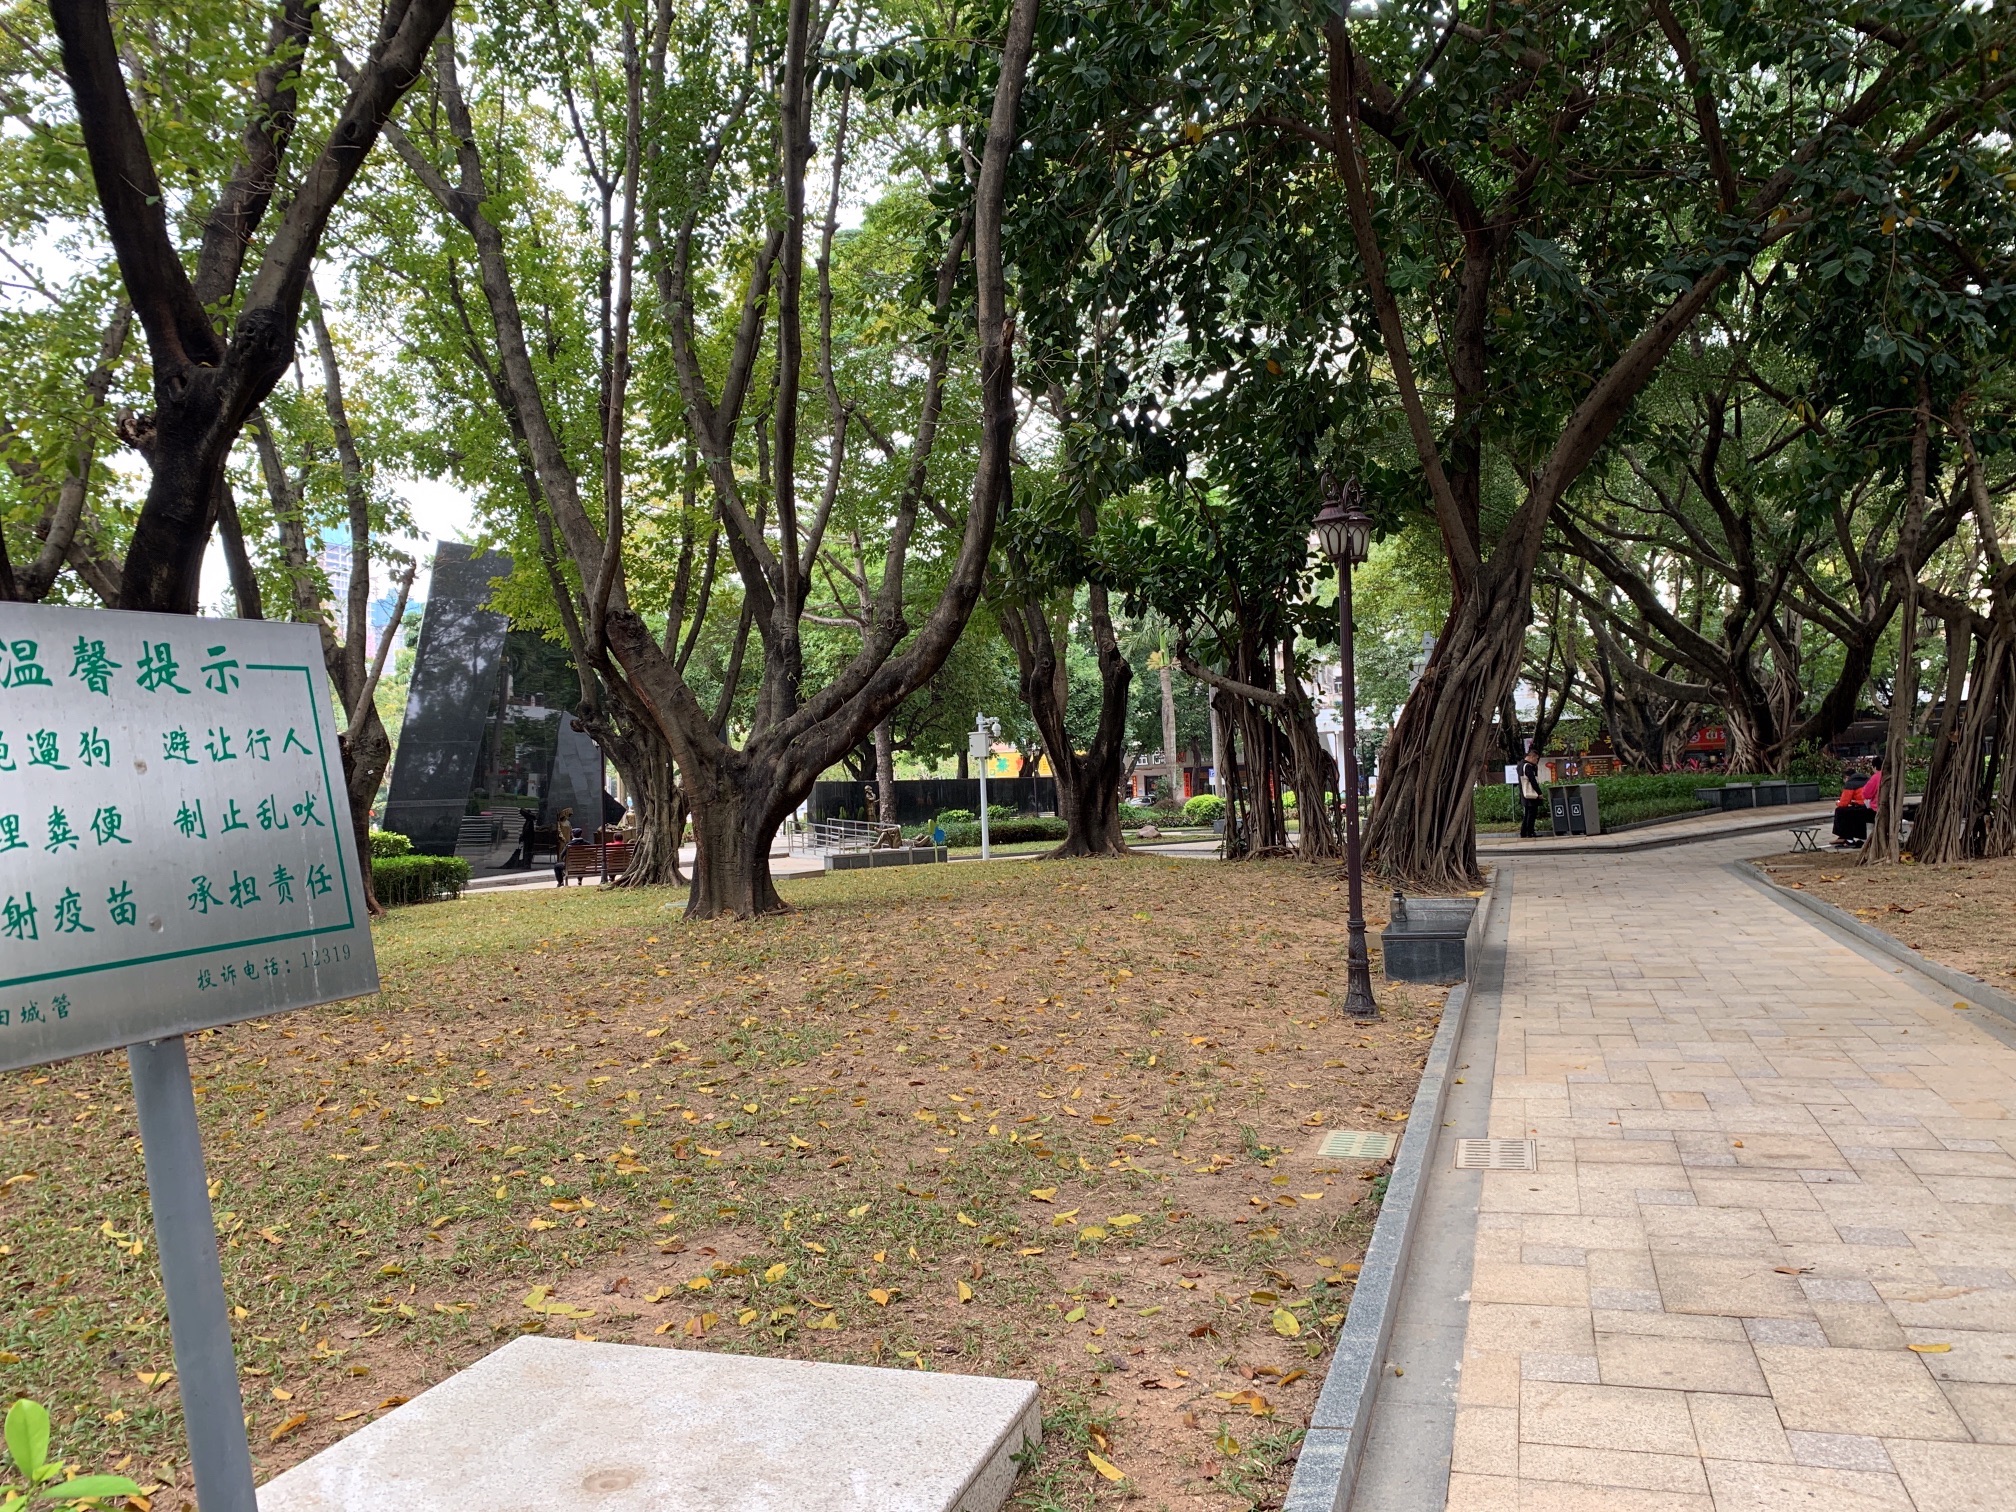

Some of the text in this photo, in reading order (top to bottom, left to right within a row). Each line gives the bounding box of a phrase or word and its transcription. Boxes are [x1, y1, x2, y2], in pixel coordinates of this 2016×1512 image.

[0, 635, 239, 696] 温馨提示
[162, 725, 313, 765] 避让行人
[173, 791, 325, 839] 制止乱吠
[1, 864, 332, 941] 射疫苗 承担责任
